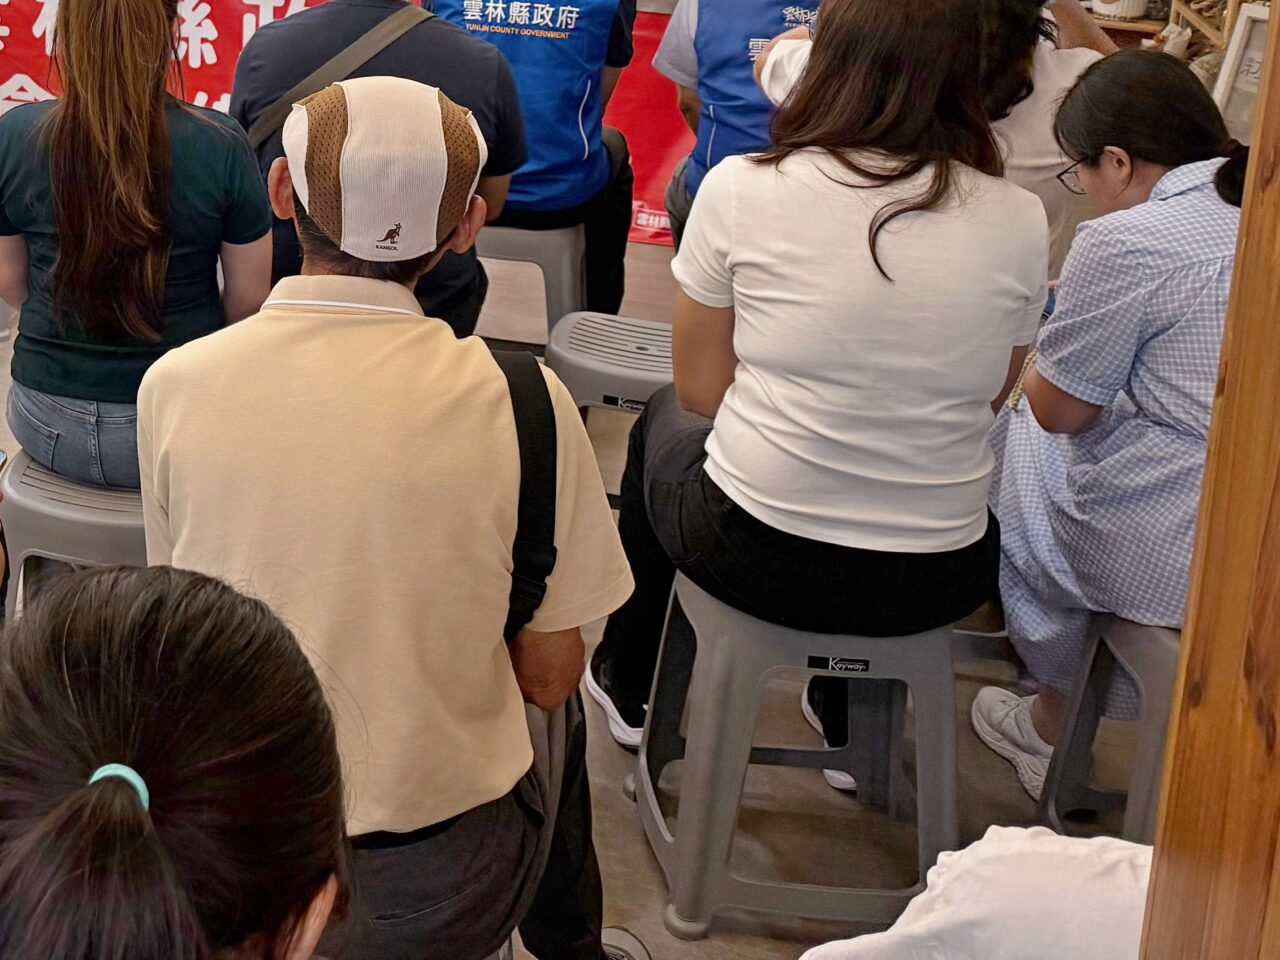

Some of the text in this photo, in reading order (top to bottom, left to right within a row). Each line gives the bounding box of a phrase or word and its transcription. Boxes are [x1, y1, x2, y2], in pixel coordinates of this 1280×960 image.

[465, 23, 570, 39] YUNLIN COUNTY GOVERNMENT
[829, 656, 864, 672] Keyway
